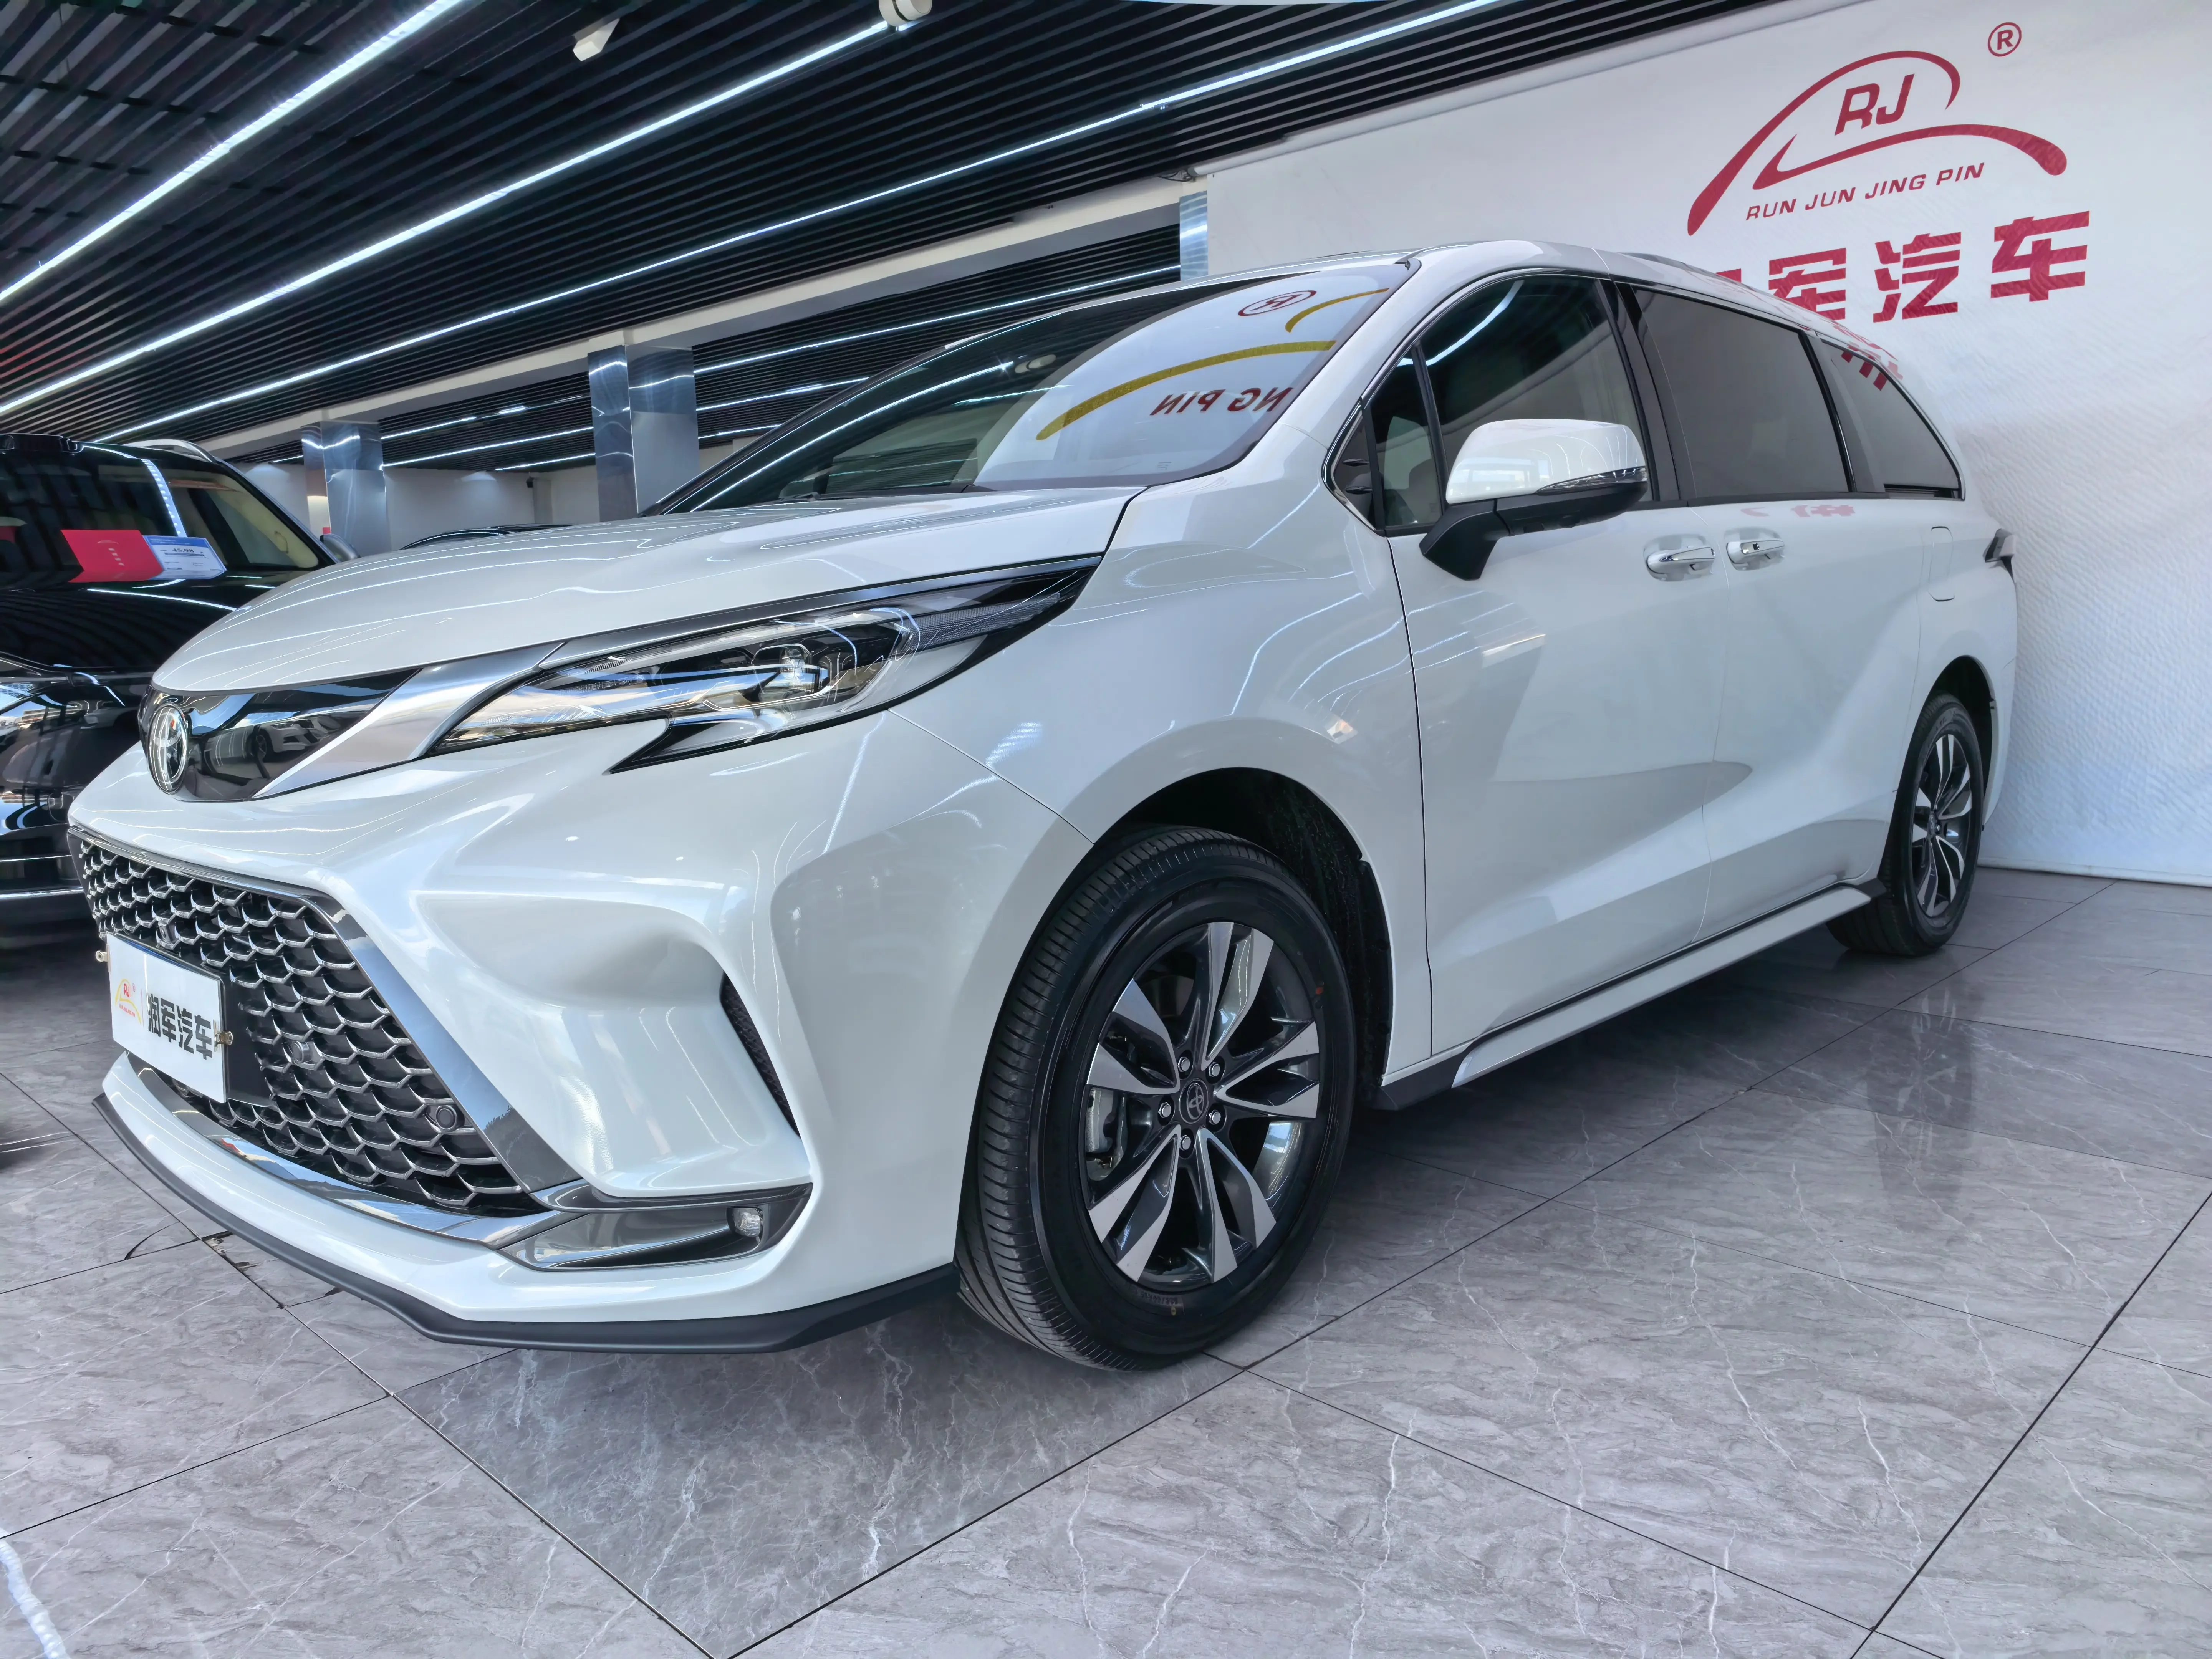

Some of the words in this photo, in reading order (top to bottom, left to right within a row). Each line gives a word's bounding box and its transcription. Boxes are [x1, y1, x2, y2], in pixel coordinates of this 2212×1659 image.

[1835, 74, 1915, 135] RJ
[1747, 198, 1796, 220] RUN
[1805, 187, 1856, 210] JUN
[1865, 174, 1927, 200] JING
[1936, 163, 1984, 186] PIN
[1715, 211, 2090, 323] 军汽车
[123, 983, 130, 998] RJ
[148, 993, 213, 1060] 润军汽车
